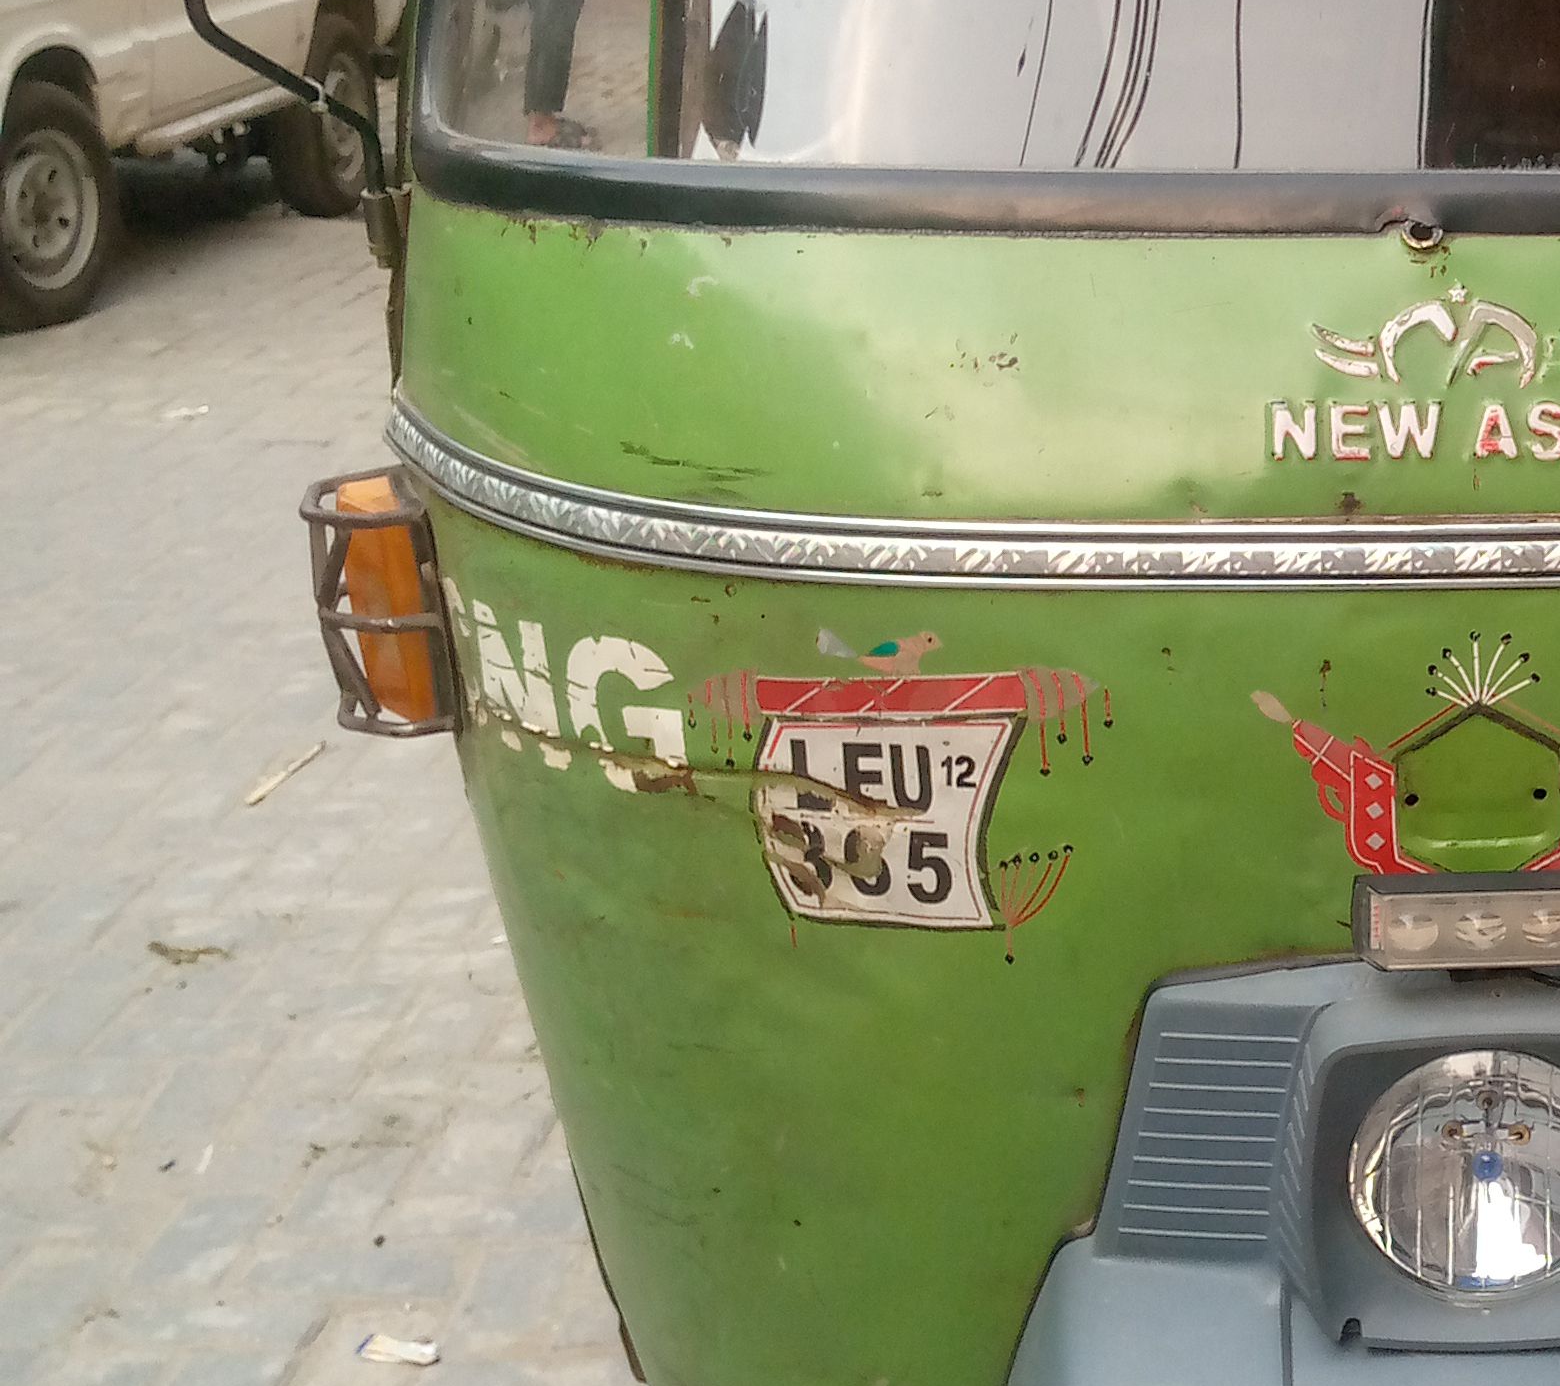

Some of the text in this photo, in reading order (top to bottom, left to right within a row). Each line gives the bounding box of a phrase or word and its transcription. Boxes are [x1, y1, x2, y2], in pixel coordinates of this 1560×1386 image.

[1268, 400, 1443, 461] NEW
[790, 738, 977, 814] LEU 12
